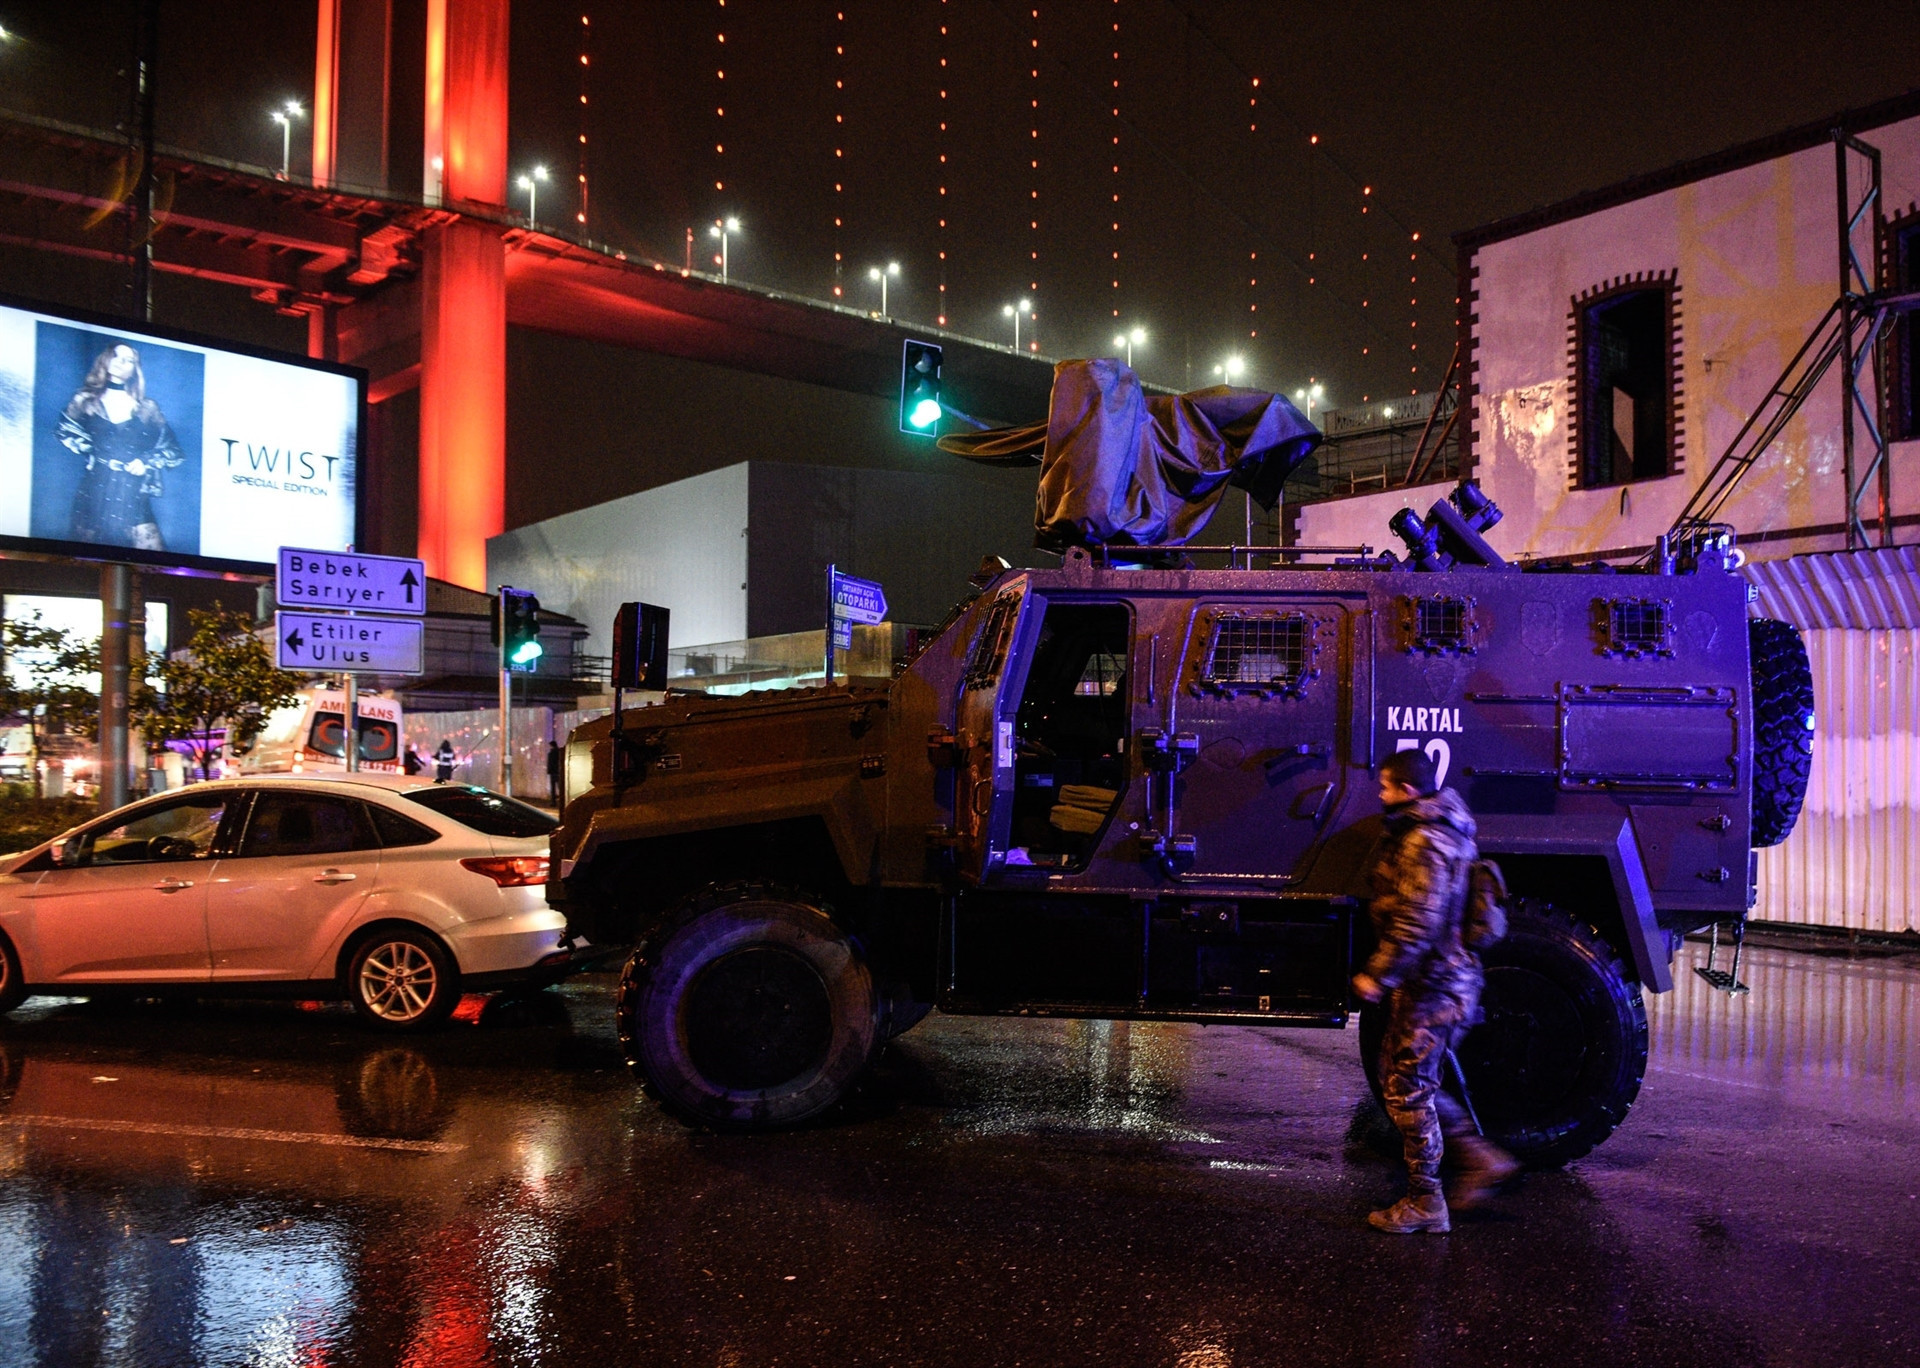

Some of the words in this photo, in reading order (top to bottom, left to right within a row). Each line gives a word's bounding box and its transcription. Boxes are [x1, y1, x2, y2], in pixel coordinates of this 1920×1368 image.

[220, 438, 340, 482] TWIST
[232, 474, 279, 490] SPECIAL
[283, 482, 328, 497] EDITION
[290, 556, 368, 579] Bebek
[290, 579, 385, 604] Sarıyer
[837, 591, 879, 611] OTOPARKI
[311, 622, 382, 641] Etiler
[312, 644, 370, 663] Ulus
[320, 700, 394, 720] AMLANS
[1387, 706, 1464, 733] KARTAL
